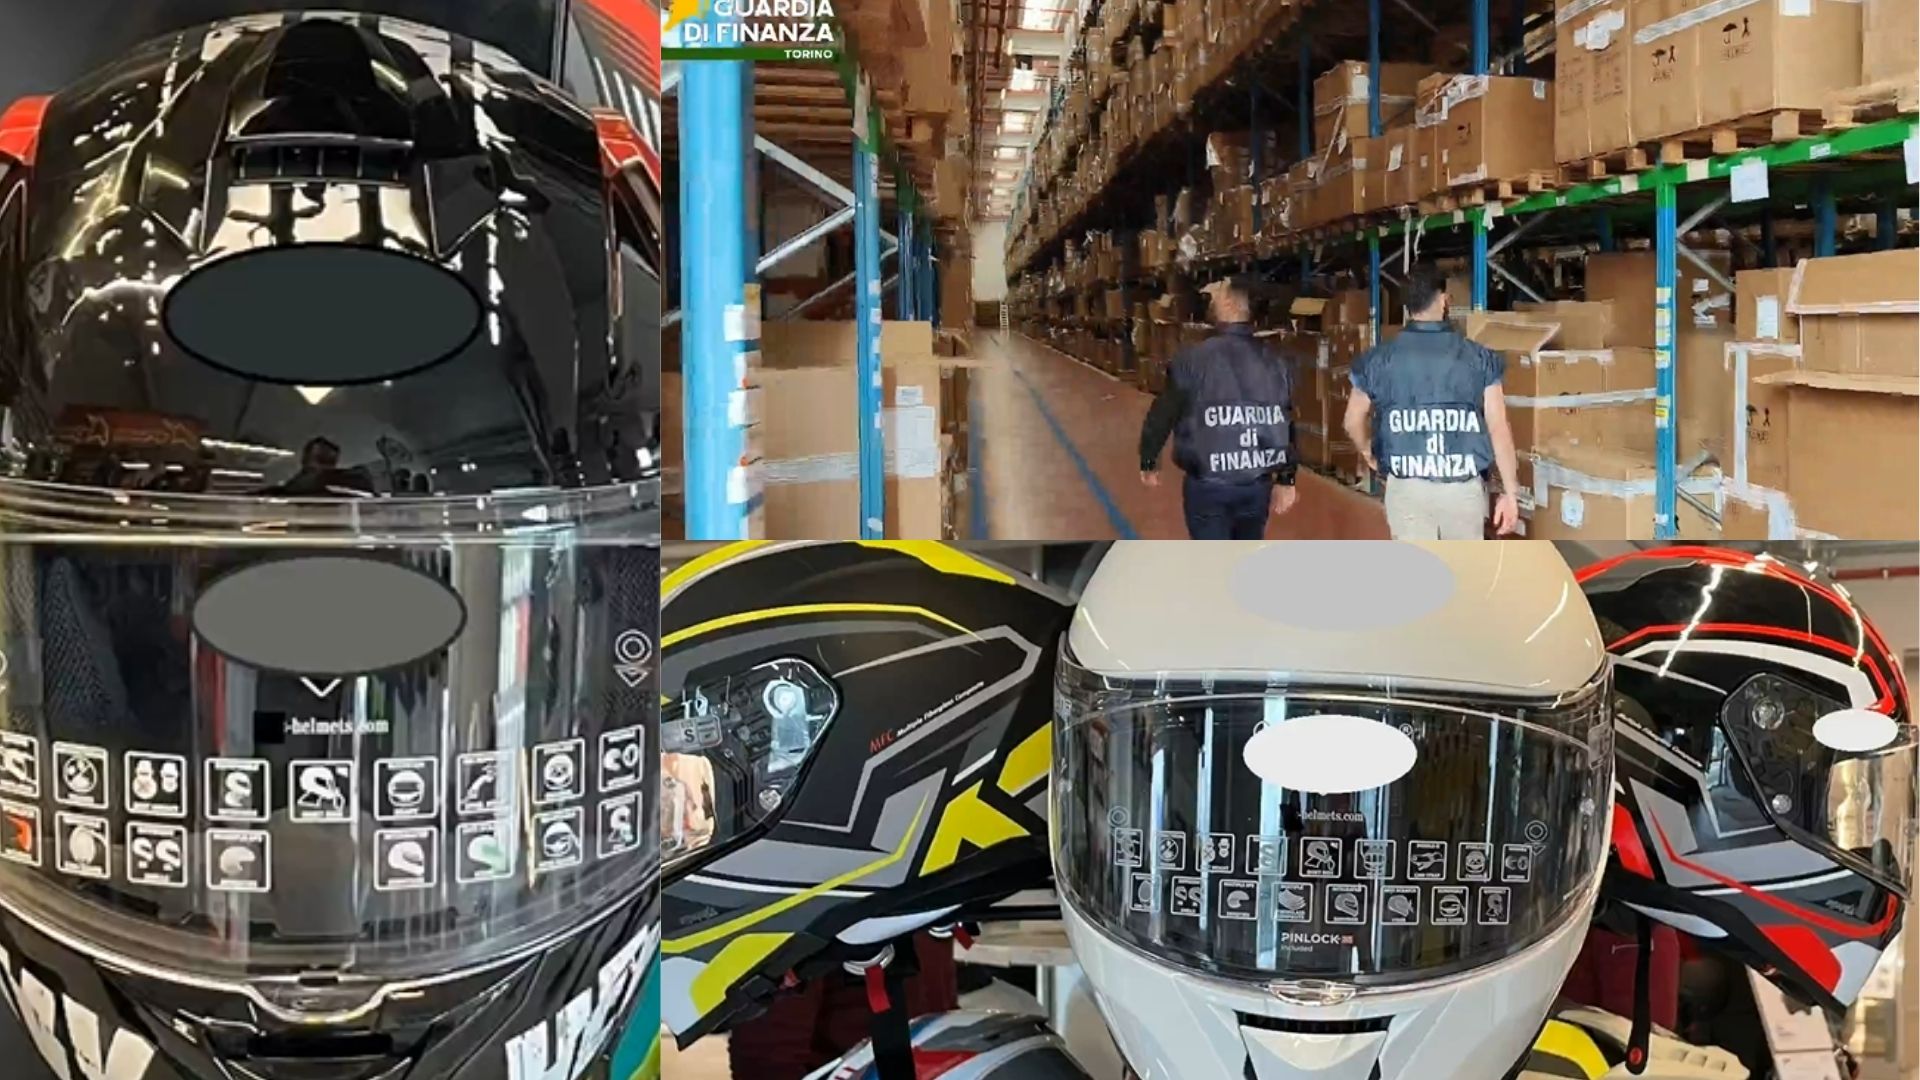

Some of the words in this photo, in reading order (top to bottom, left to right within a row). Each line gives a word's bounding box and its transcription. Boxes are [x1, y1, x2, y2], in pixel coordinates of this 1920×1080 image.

[1204, 405, 1285, 428] GUARDIA
[1389, 409, 1480, 432] GUARDIA
[1240, 428, 1258, 447] di
[1426, 433, 1445, 454] di
[1209, 448, 1287, 472] FINANZA
[1390, 454, 1478, 477] FINANZA
[284, 717, 389, 735] -helmetscom
[684, 729, 695, 742] S
[1281, 932, 1340, 945] PINLOCK
